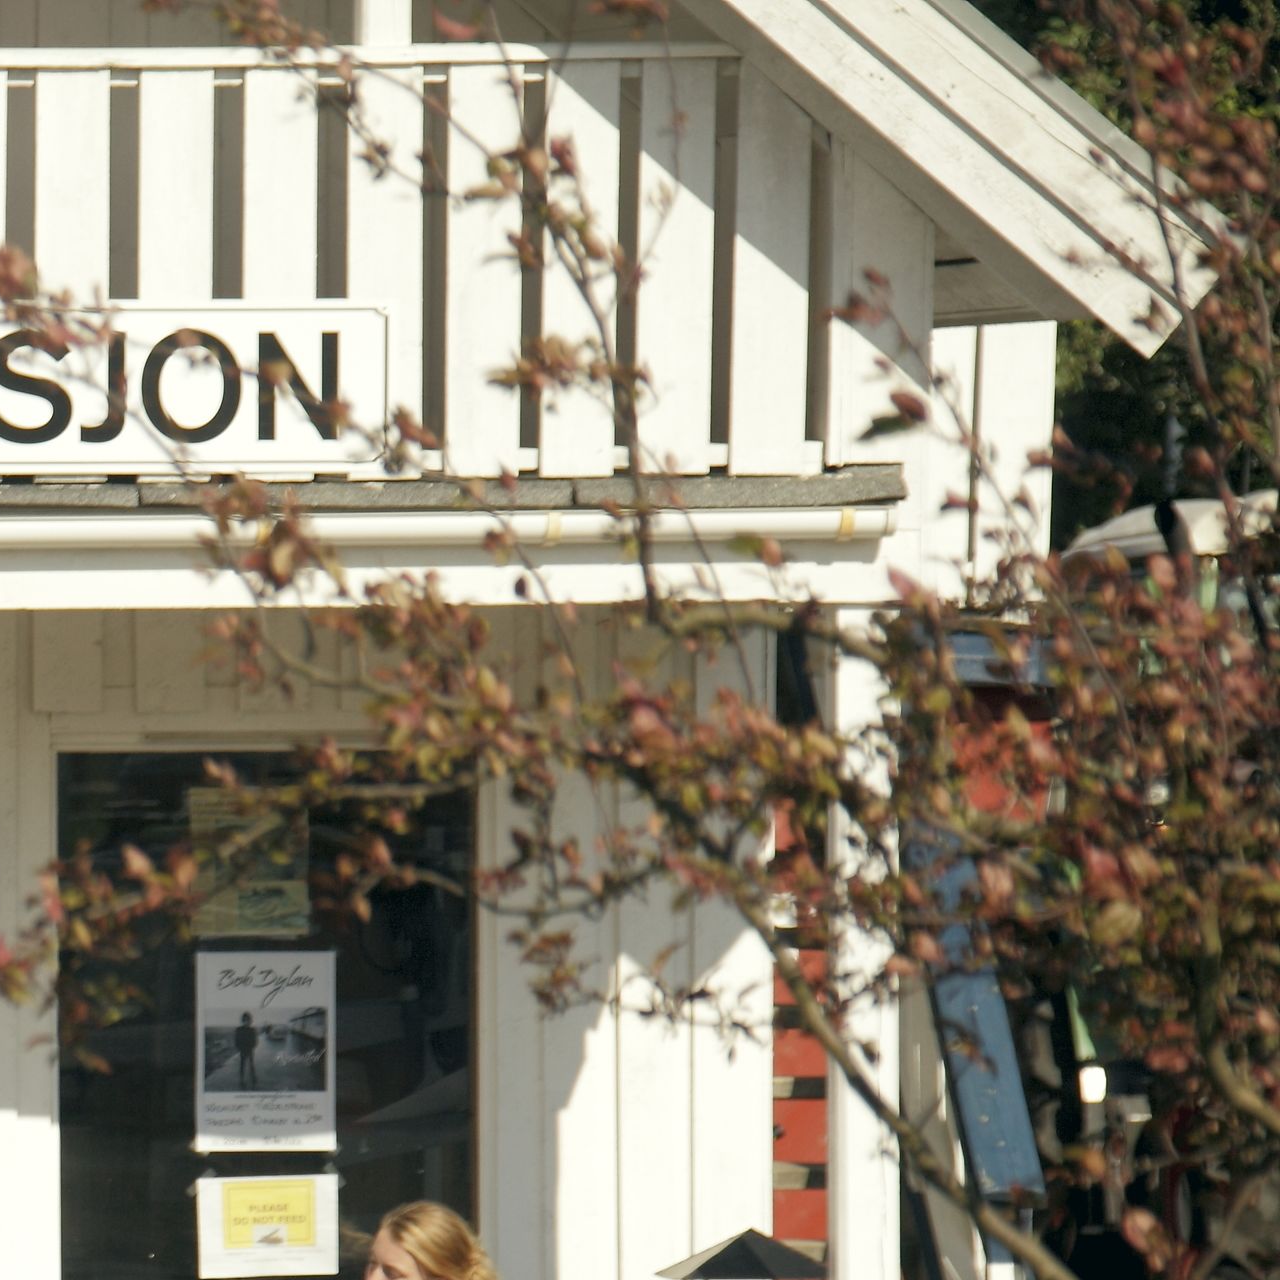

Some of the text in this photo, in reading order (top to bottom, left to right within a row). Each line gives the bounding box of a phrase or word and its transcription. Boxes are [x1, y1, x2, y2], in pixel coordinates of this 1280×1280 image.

[217, 965, 316, 1008] Bob Dylan
[248, 1203, 290, 1213] PLEASE
[253, 1215, 277, 1225] NOT
[281, 1214, 307, 1225] FEED
